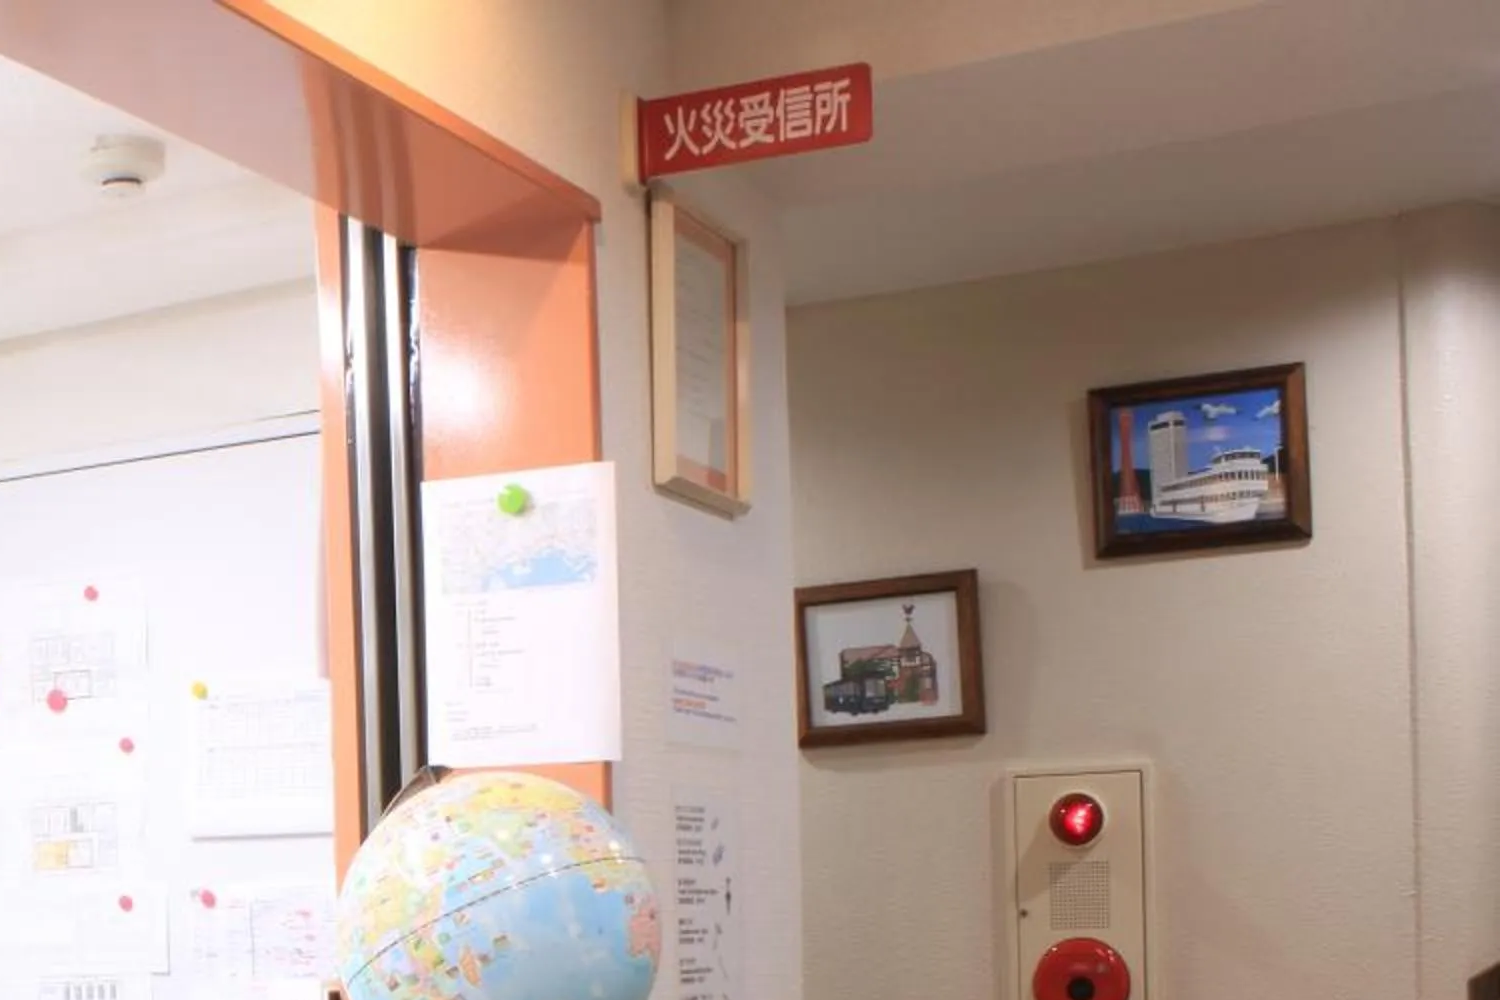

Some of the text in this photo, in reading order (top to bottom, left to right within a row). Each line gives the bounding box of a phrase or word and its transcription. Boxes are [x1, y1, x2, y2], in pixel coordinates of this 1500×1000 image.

[663, 77, 852, 161] 火災受信所
